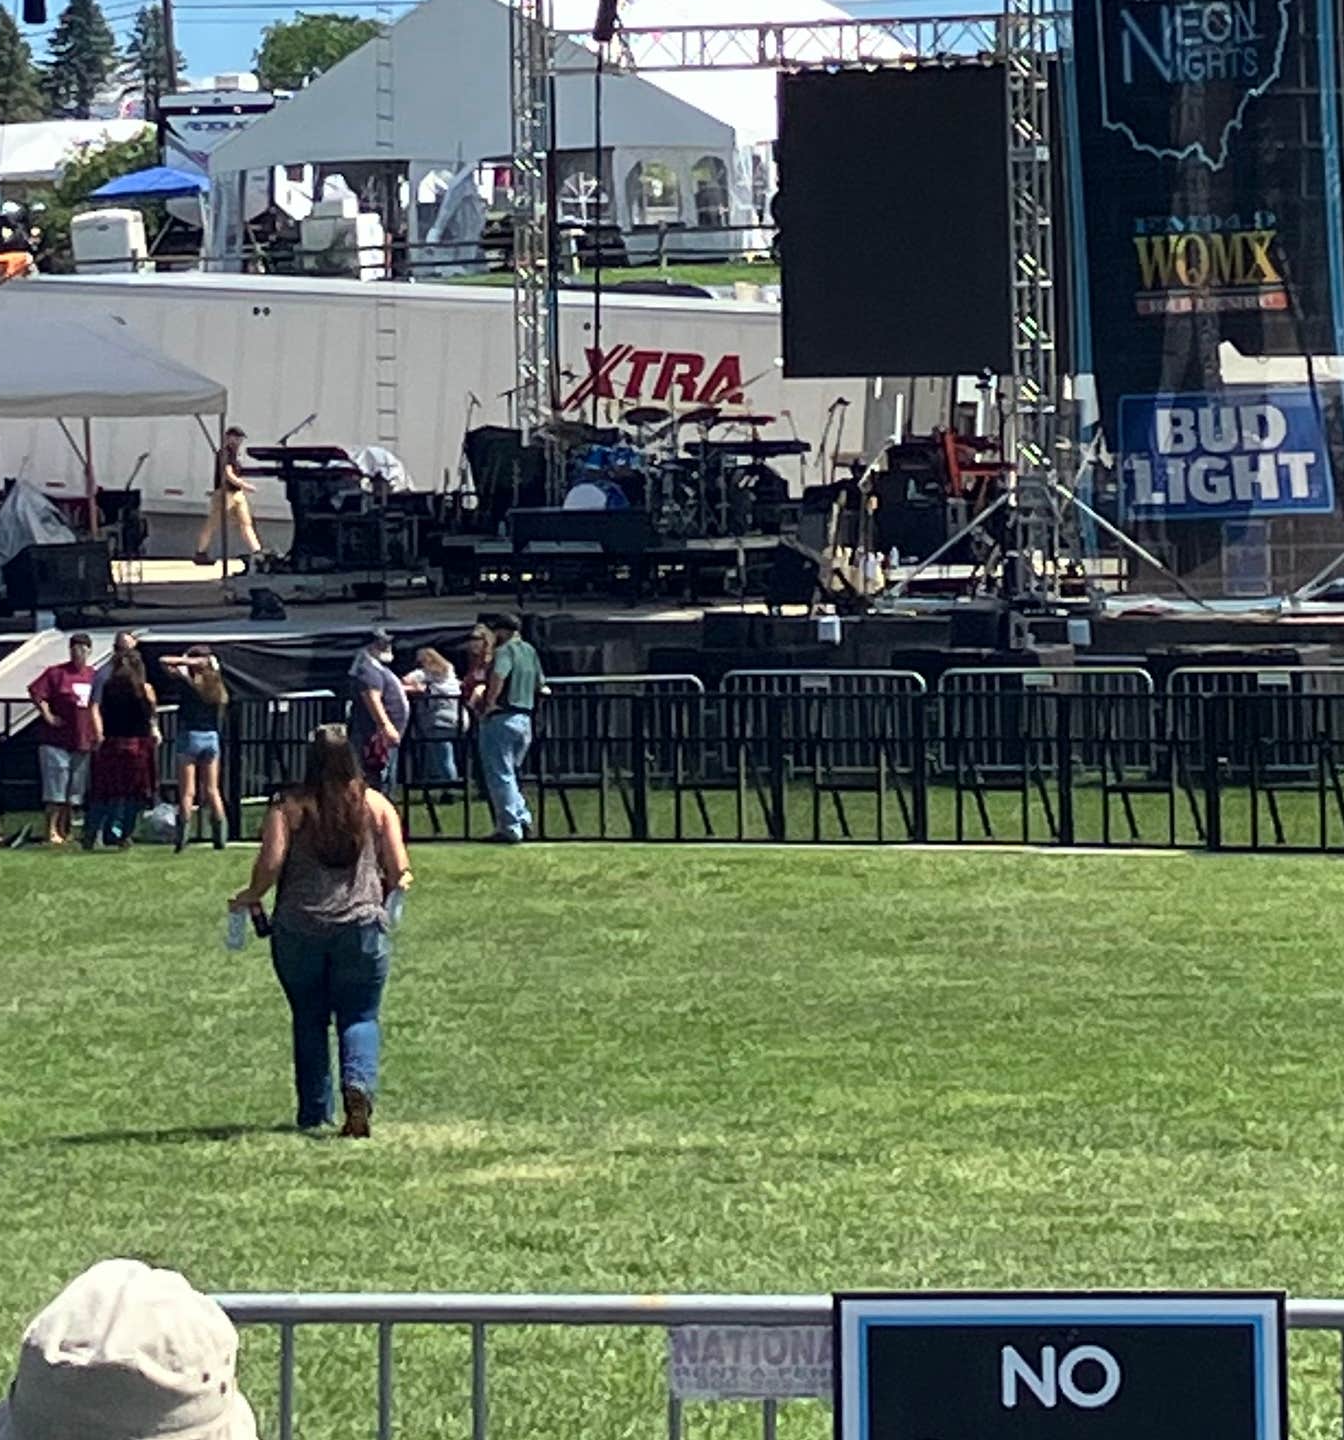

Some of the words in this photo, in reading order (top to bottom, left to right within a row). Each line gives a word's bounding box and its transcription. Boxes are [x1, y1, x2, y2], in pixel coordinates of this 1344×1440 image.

[1133, 229, 1284, 291] WQMX
[559, 344, 745, 412] XTRA
[1156, 404, 1287, 454] BUD
[1130, 452, 1316, 505] LIGHT
[1001, 1344, 1121, 1408] NO
